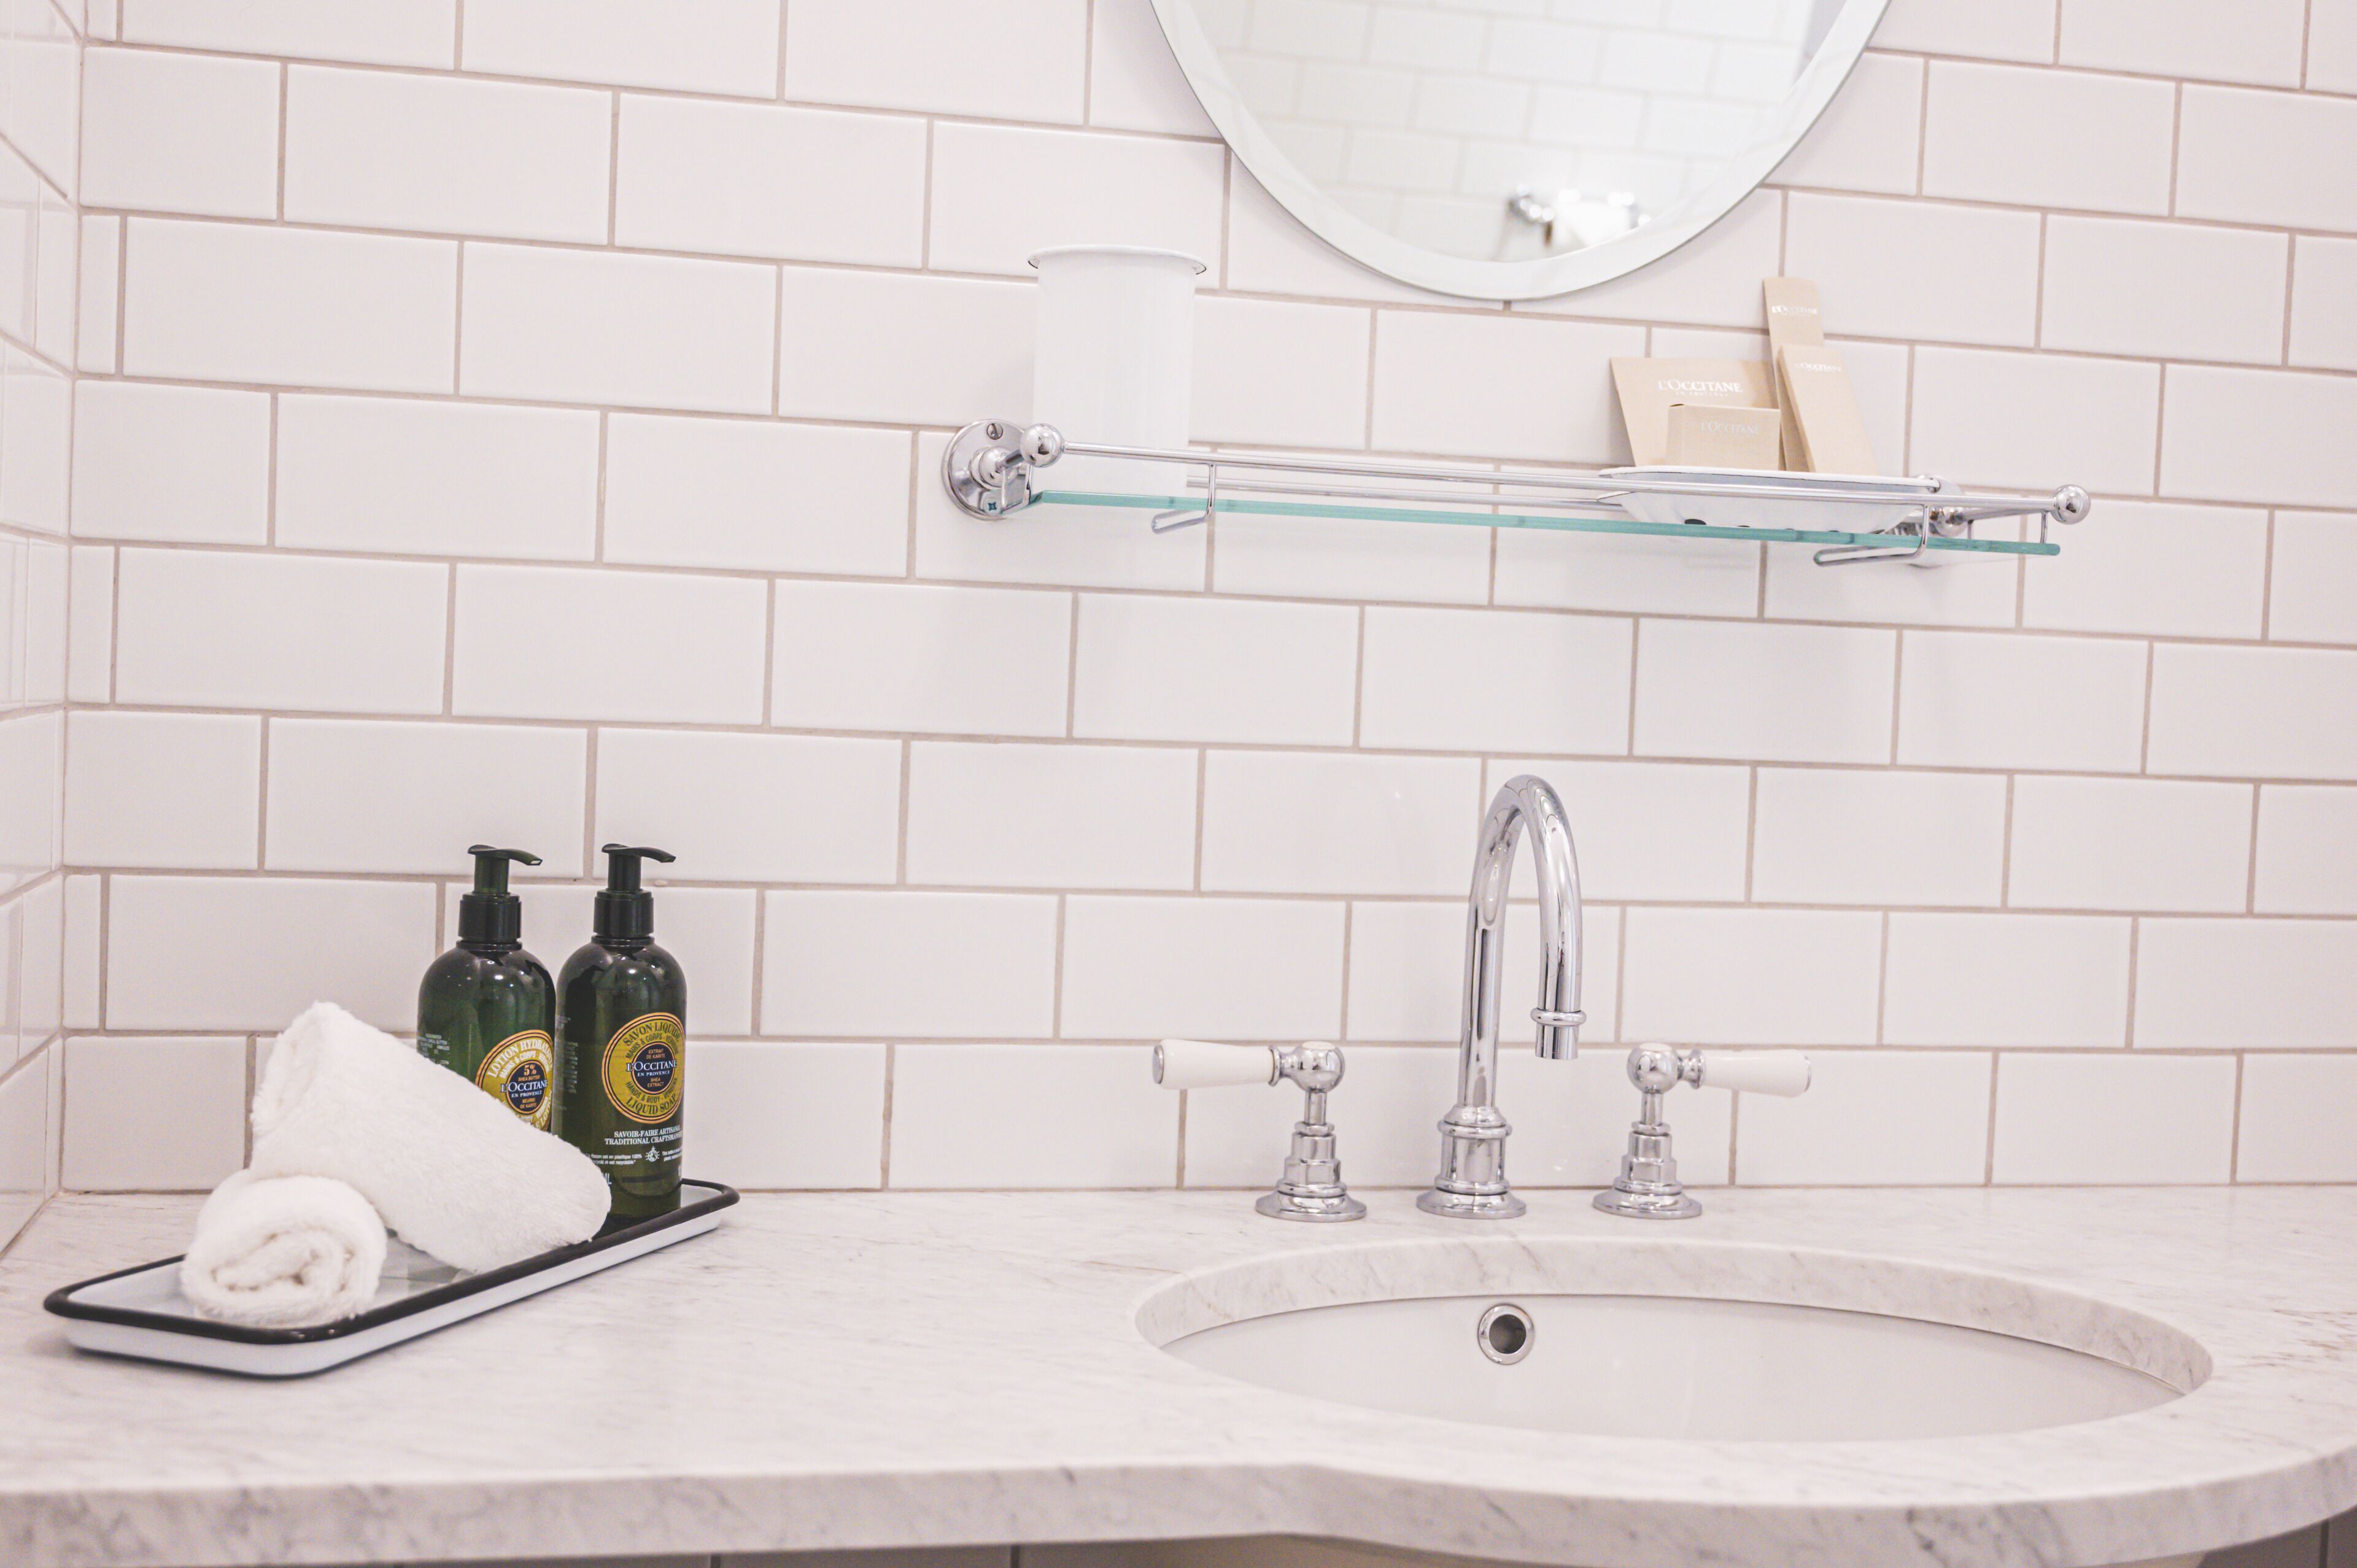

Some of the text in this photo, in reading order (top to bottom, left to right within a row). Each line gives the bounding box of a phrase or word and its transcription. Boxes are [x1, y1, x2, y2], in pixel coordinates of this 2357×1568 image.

[1658, 379, 1743, 393] L'OCCITANE
[622, 1022, 652, 1047] SAVON
[625, 1041, 641, 1060] MAINS
[645, 1033, 663, 1042] CORPS
[487, 1044, 520, 1078] LOTION
[627, 1059, 678, 1072] L'OCCITANE
[524, 1064, 537, 1076] 5%
[500, 1079, 548, 1092] L'OCCITANE
[625, 1081, 641, 1099] HANDS
[626, 1094, 678, 1114] LIQUID SOAP
[614, 1129, 659, 1138] SAVOIR-FAIRE
[605, 1137, 651, 1145] TRADITIONAL
